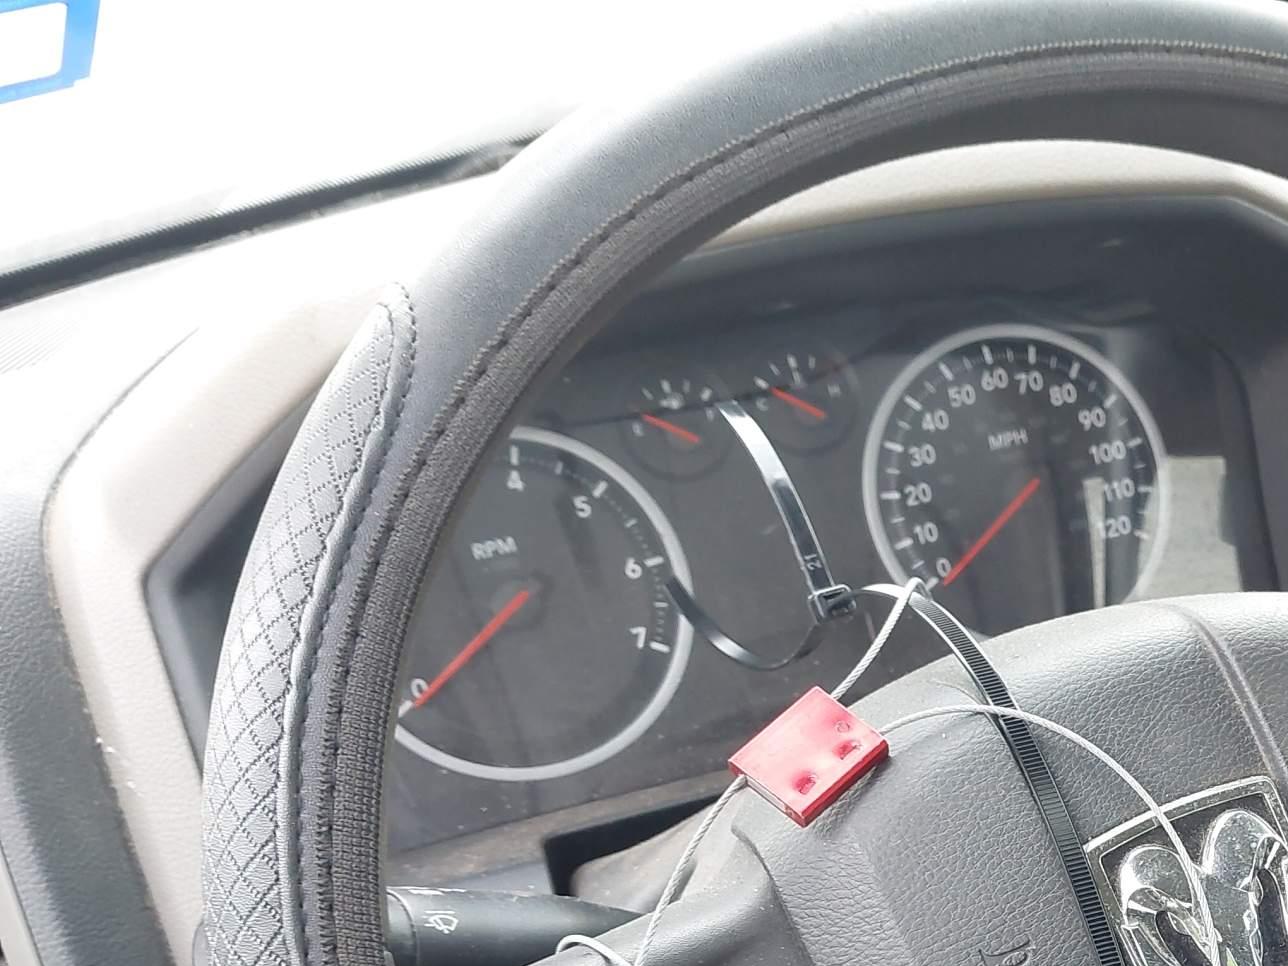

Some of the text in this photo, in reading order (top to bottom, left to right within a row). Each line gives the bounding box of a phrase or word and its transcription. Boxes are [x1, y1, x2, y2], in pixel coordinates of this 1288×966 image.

[981, 368, 1009, 391] 60
[1015, 371, 1043, 394] 70
[948, 384, 976, 407] 50
[1050, 383, 1077, 406] 80
[921, 409, 949, 431] 40
[1079, 407, 1106, 431] 90
[989, 429, 1028, 449] MPH
[910, 444, 936, 466] 30
[1089, 440, 1126, 465] 100
[507, 471, 524, 491] 4
[1104, 478, 1135, 501] 110
[904, 483, 932, 506] 20
[574, 496, 592, 518] 5
[914, 522, 938, 544] 10
[471, 536, 517, 560] RPM
[624, 558, 643, 579] 6
[936, 557, 951, 577] 0
[629, 628, 646, 649] 7
[411, 679, 429, 699] 0
